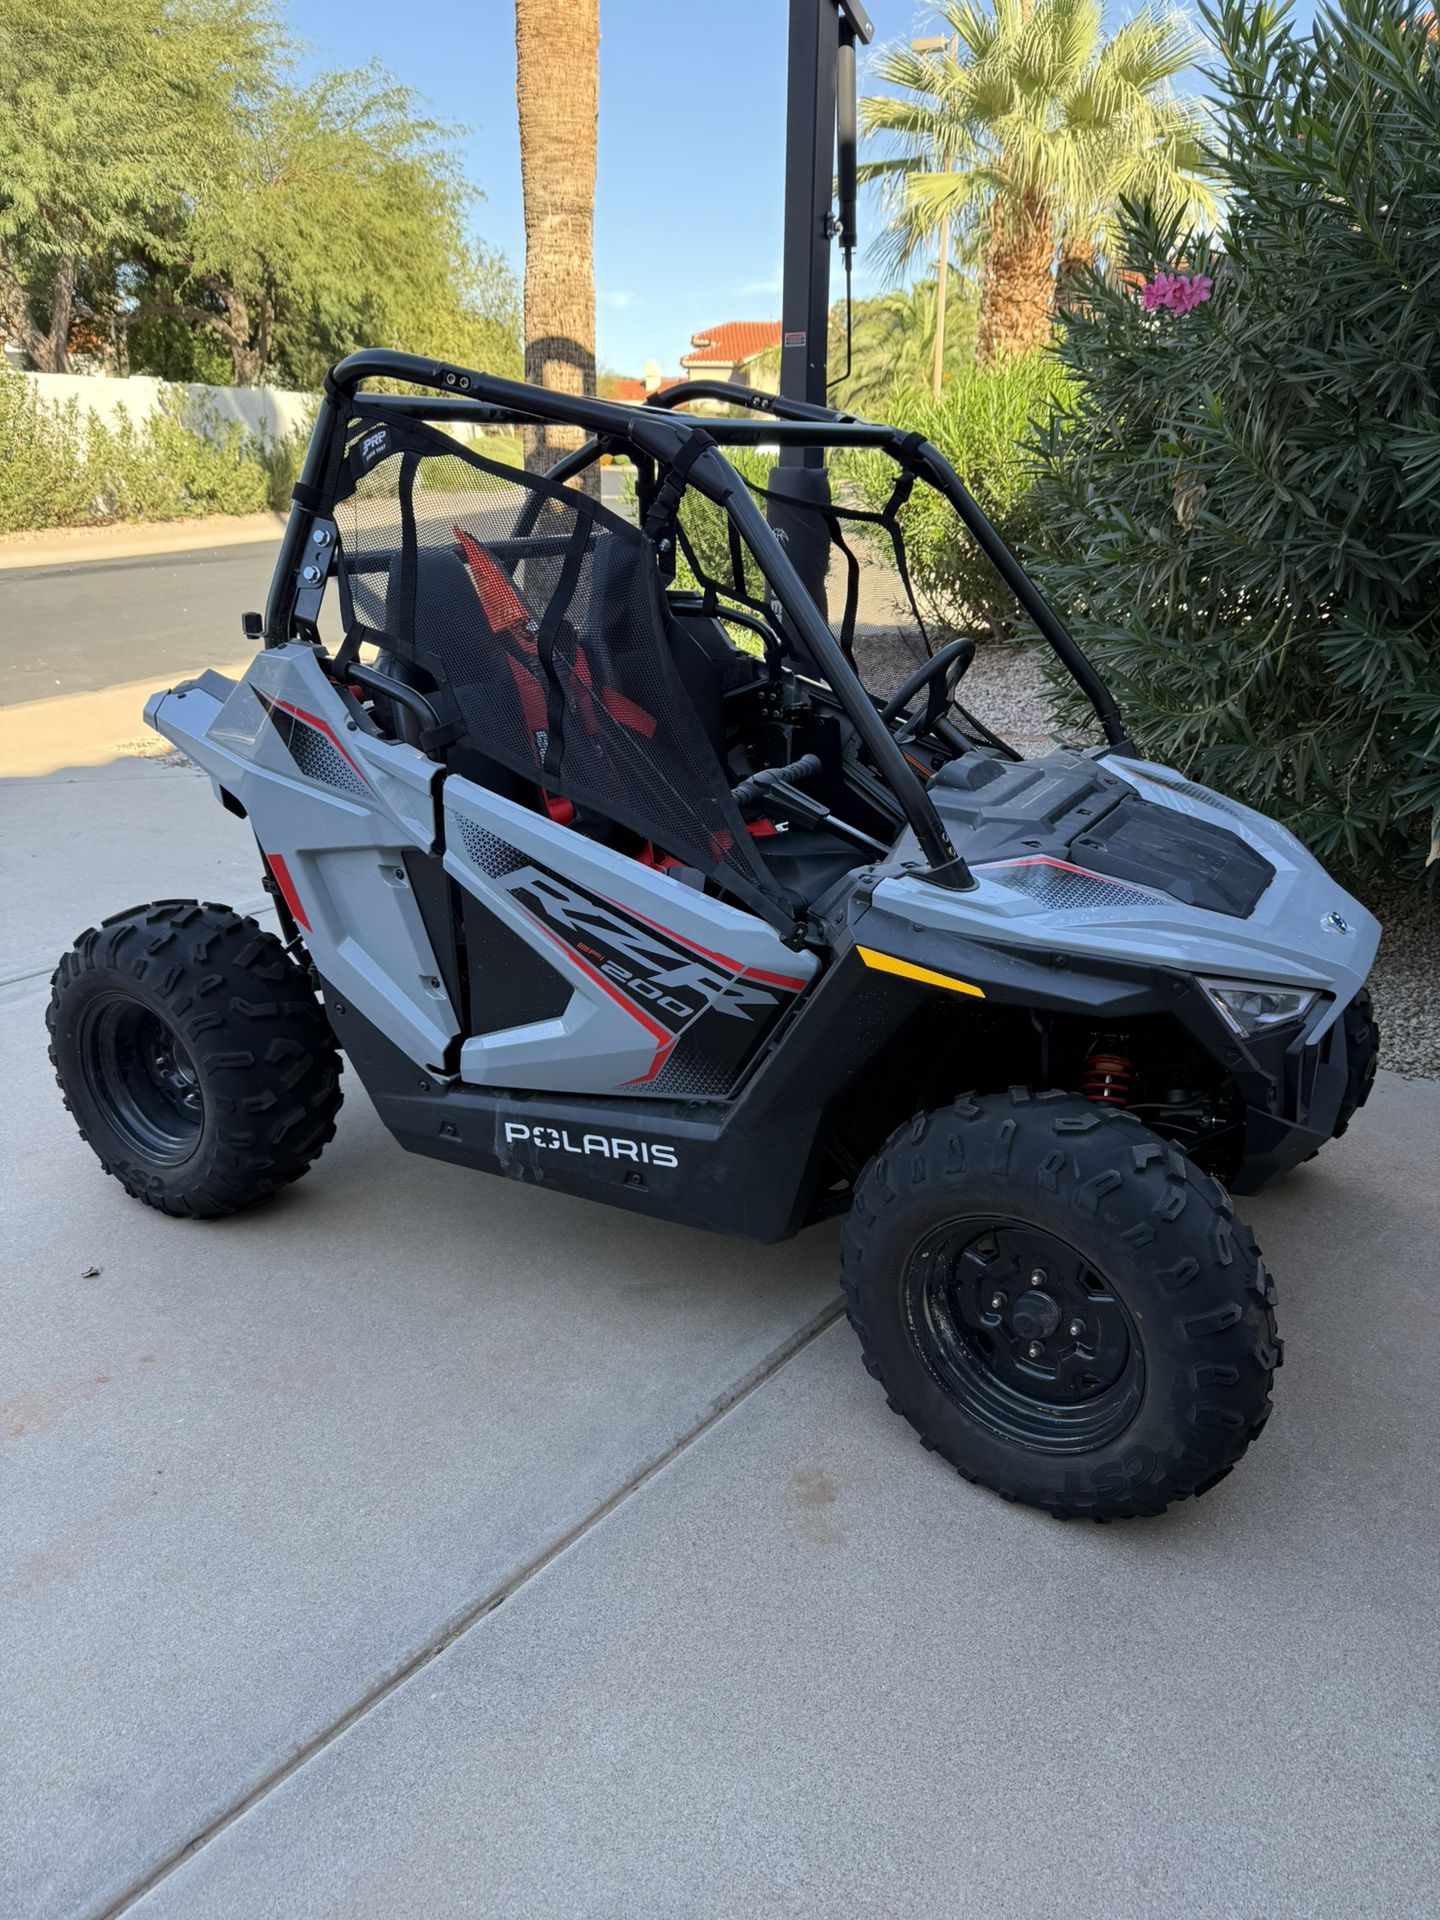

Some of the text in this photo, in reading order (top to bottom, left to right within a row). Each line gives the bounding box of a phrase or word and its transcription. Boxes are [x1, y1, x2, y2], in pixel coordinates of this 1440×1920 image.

[362, 430, 387, 456] PRP
[503, 865, 780, 1022] RZR
[600, 959, 694, 1018] 200
[504, 1121, 679, 1169] POLARIS
[1056, 1444, 1158, 1502] CST
